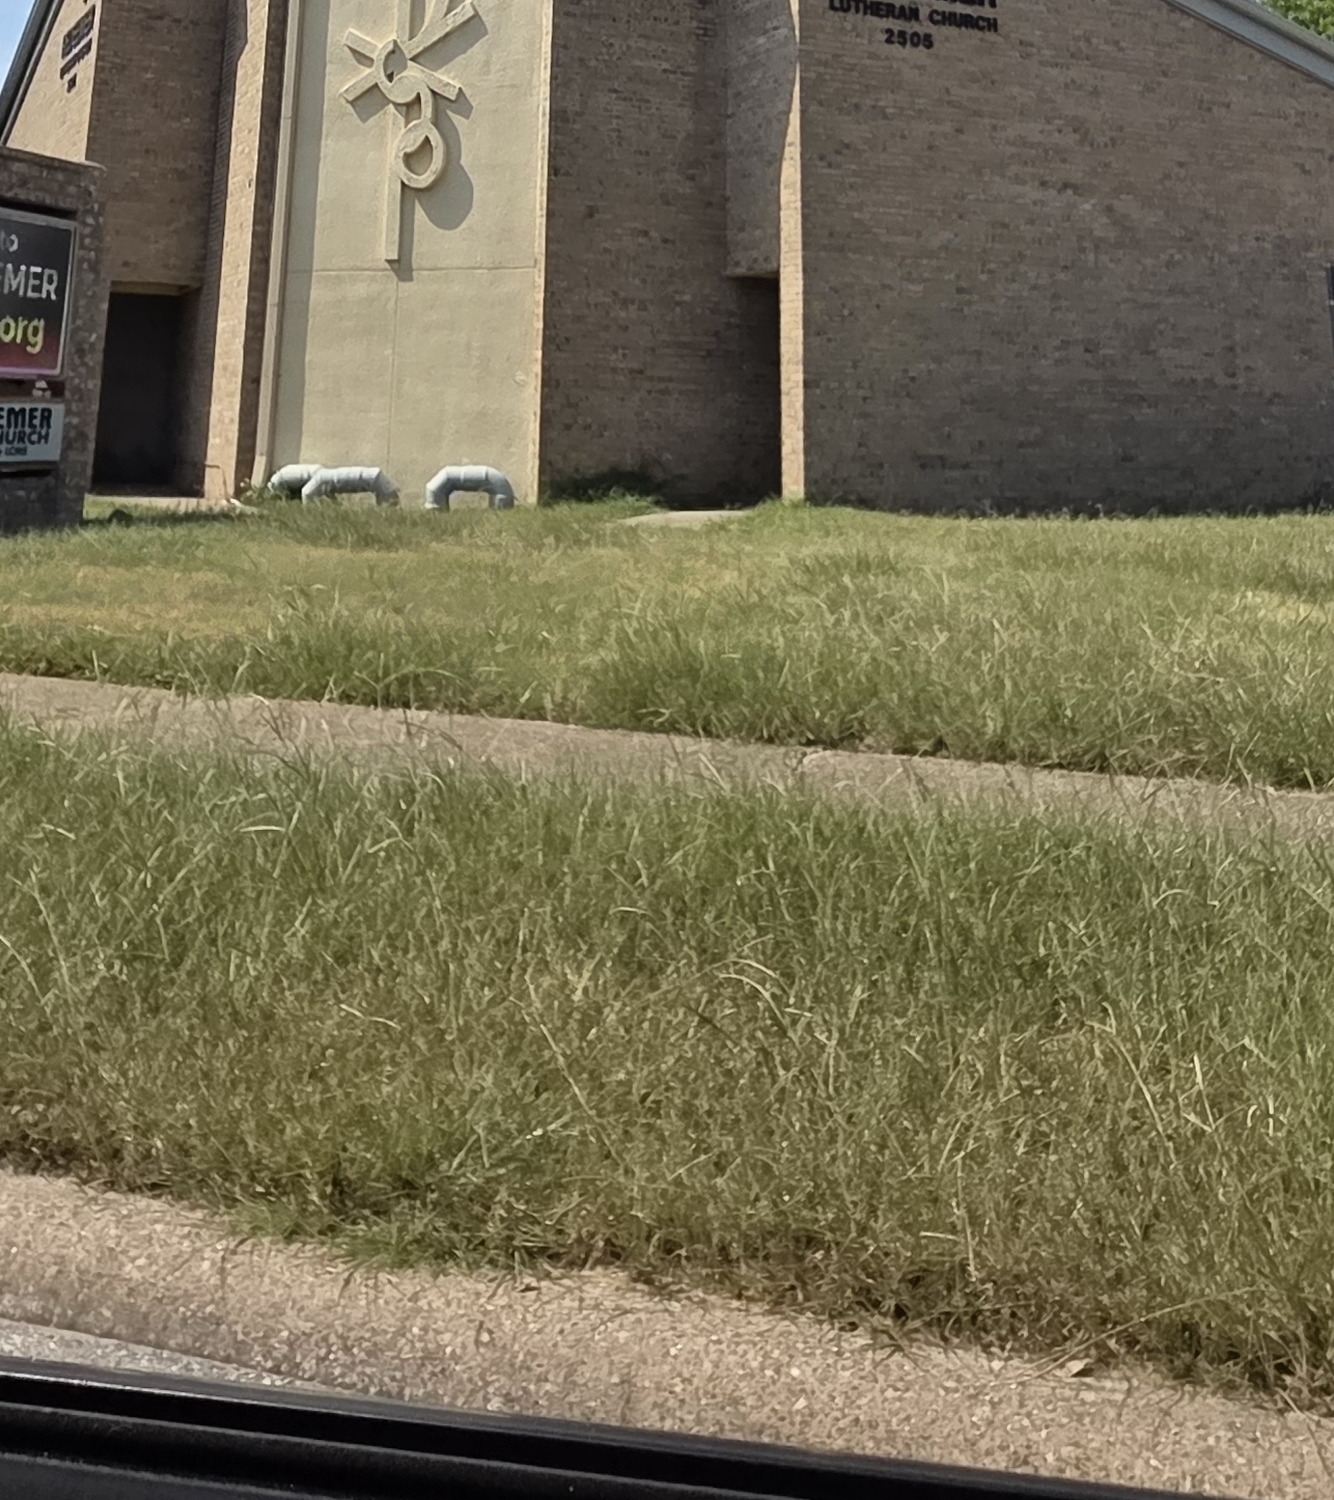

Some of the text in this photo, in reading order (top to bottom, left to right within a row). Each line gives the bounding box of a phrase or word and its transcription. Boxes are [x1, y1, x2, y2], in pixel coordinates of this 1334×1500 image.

[928, 9, 998, 33] CHURCH
[884, 28, 934, 50] 2505
[0, 233, 19, 252] to
